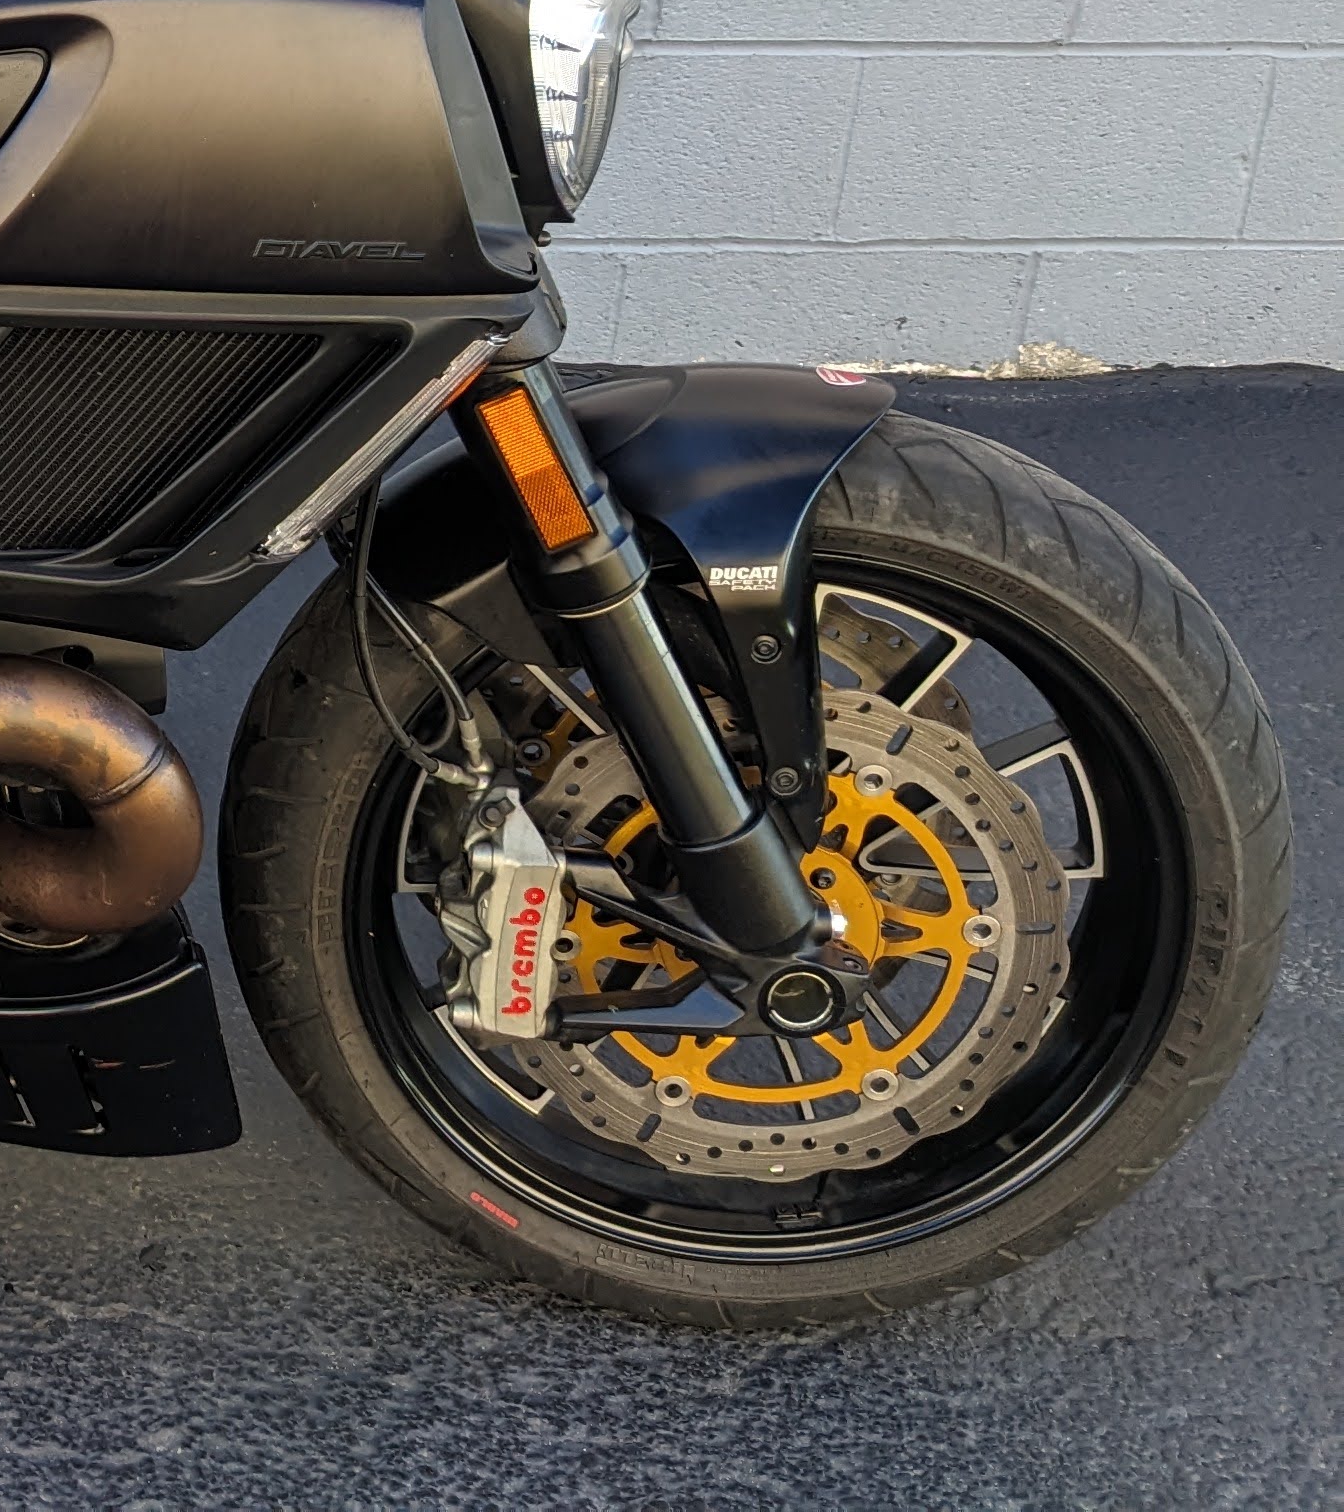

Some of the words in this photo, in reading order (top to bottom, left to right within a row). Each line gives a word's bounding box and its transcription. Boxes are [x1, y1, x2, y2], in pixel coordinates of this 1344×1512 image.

[253, 239, 426, 261] DIAVEL
[710, 566, 778, 580] DUCATI
[501, 887, 546, 1016] brembo
